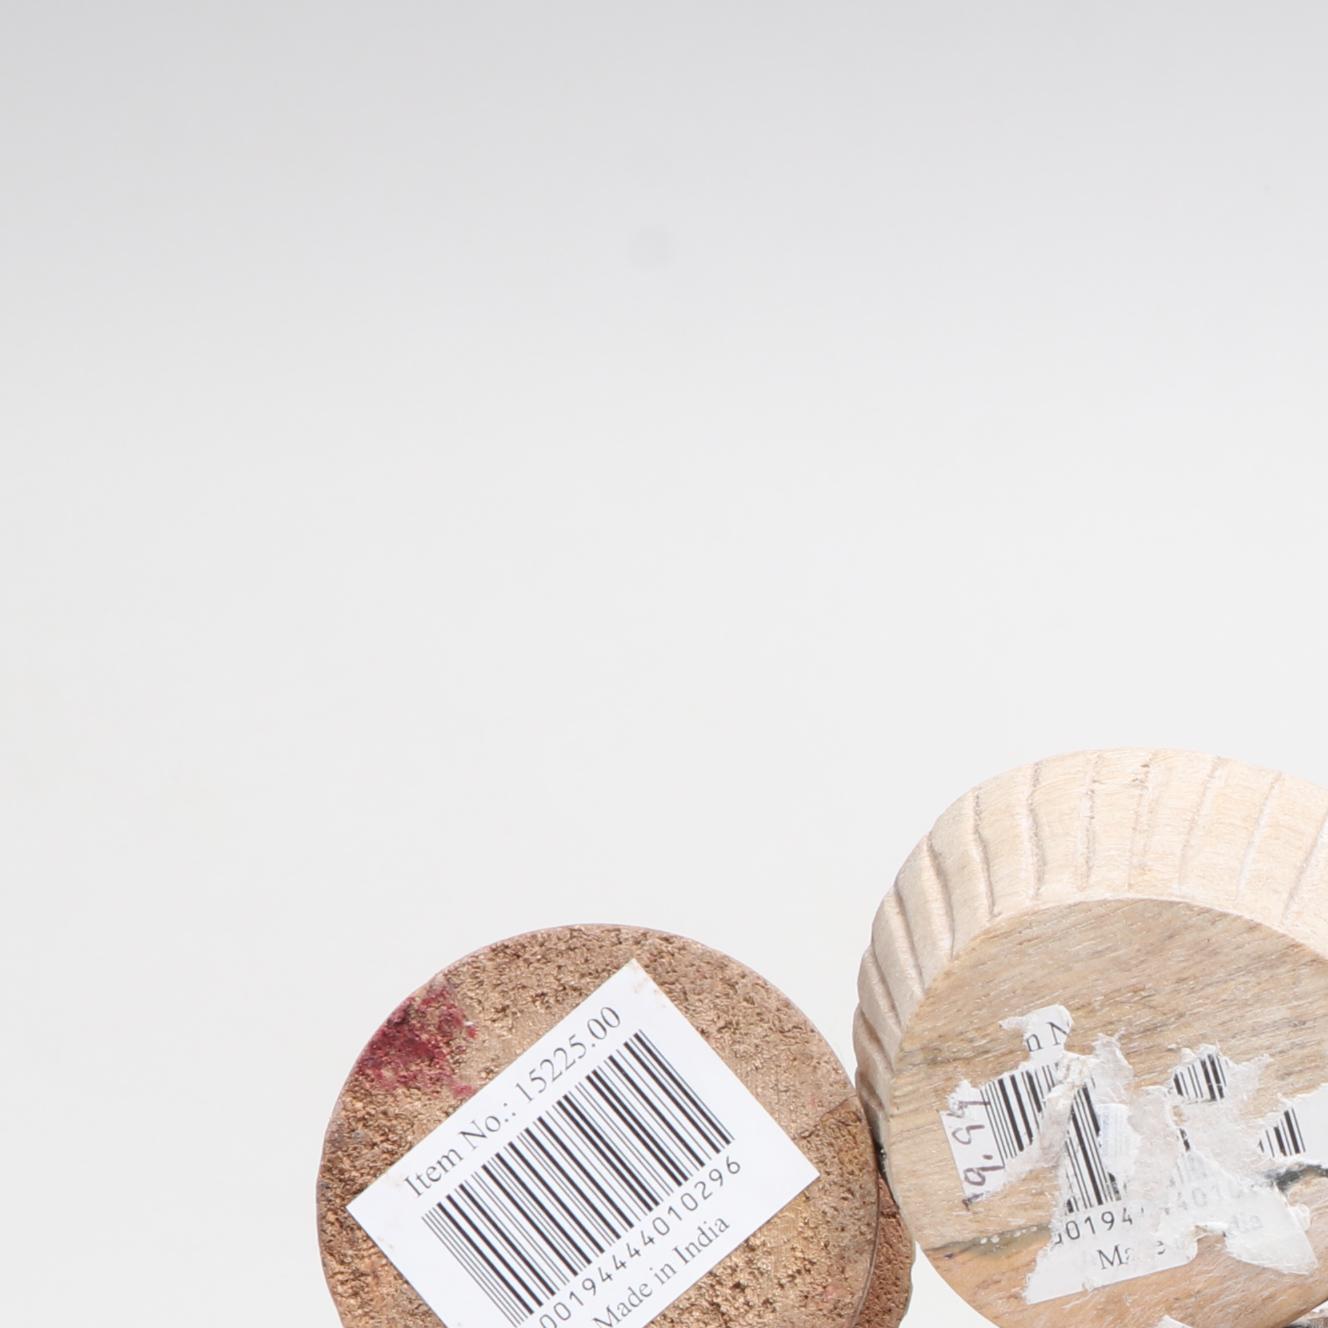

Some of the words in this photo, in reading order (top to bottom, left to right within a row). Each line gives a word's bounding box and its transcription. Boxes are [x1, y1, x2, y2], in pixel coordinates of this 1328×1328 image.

[403, 1148, 464, 1197] Item
[458, 1102, 516, 1150] No.:
[515, 1006, 621, 1102] 15225.00
[649, 1263, 677, 1285] in
[672, 1217, 730, 1265] India
